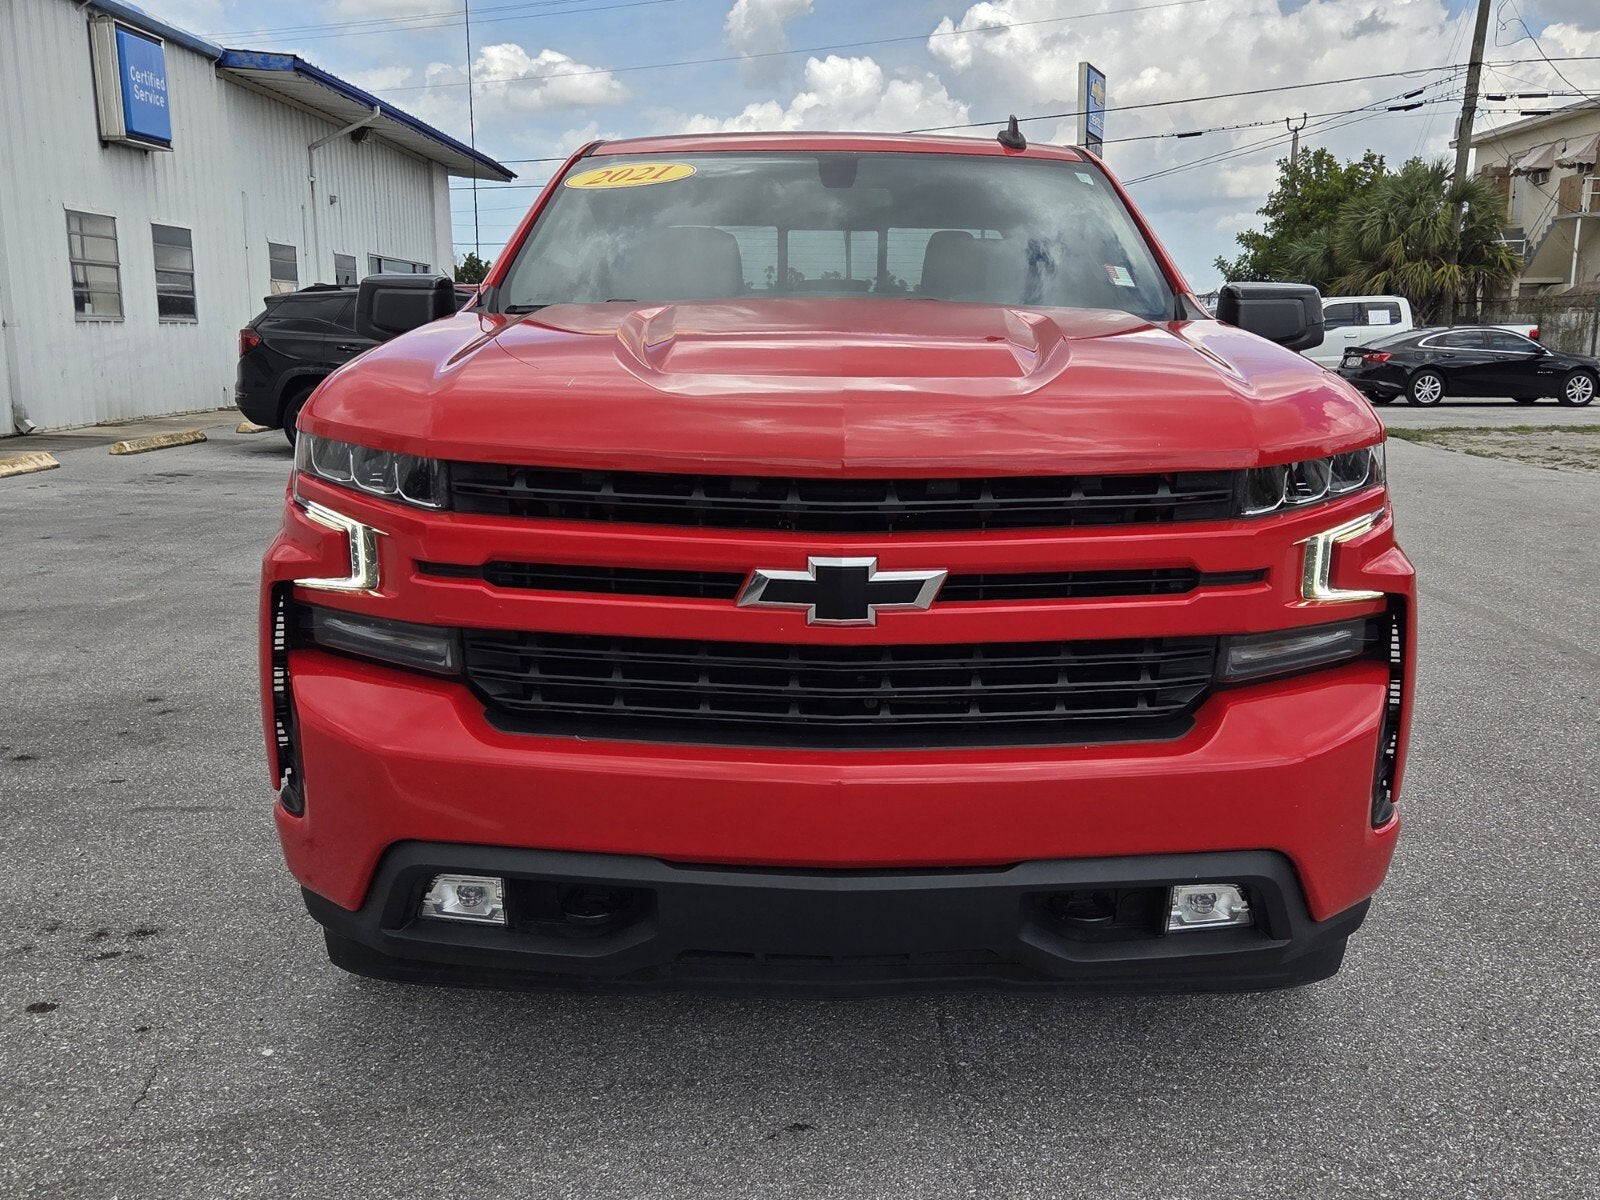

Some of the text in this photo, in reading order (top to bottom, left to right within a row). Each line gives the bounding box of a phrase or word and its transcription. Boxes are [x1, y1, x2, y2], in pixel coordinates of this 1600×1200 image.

[129, 65, 166, 92] Certified
[134, 84, 165, 108] Service
[583, 165, 676, 186] 2021
